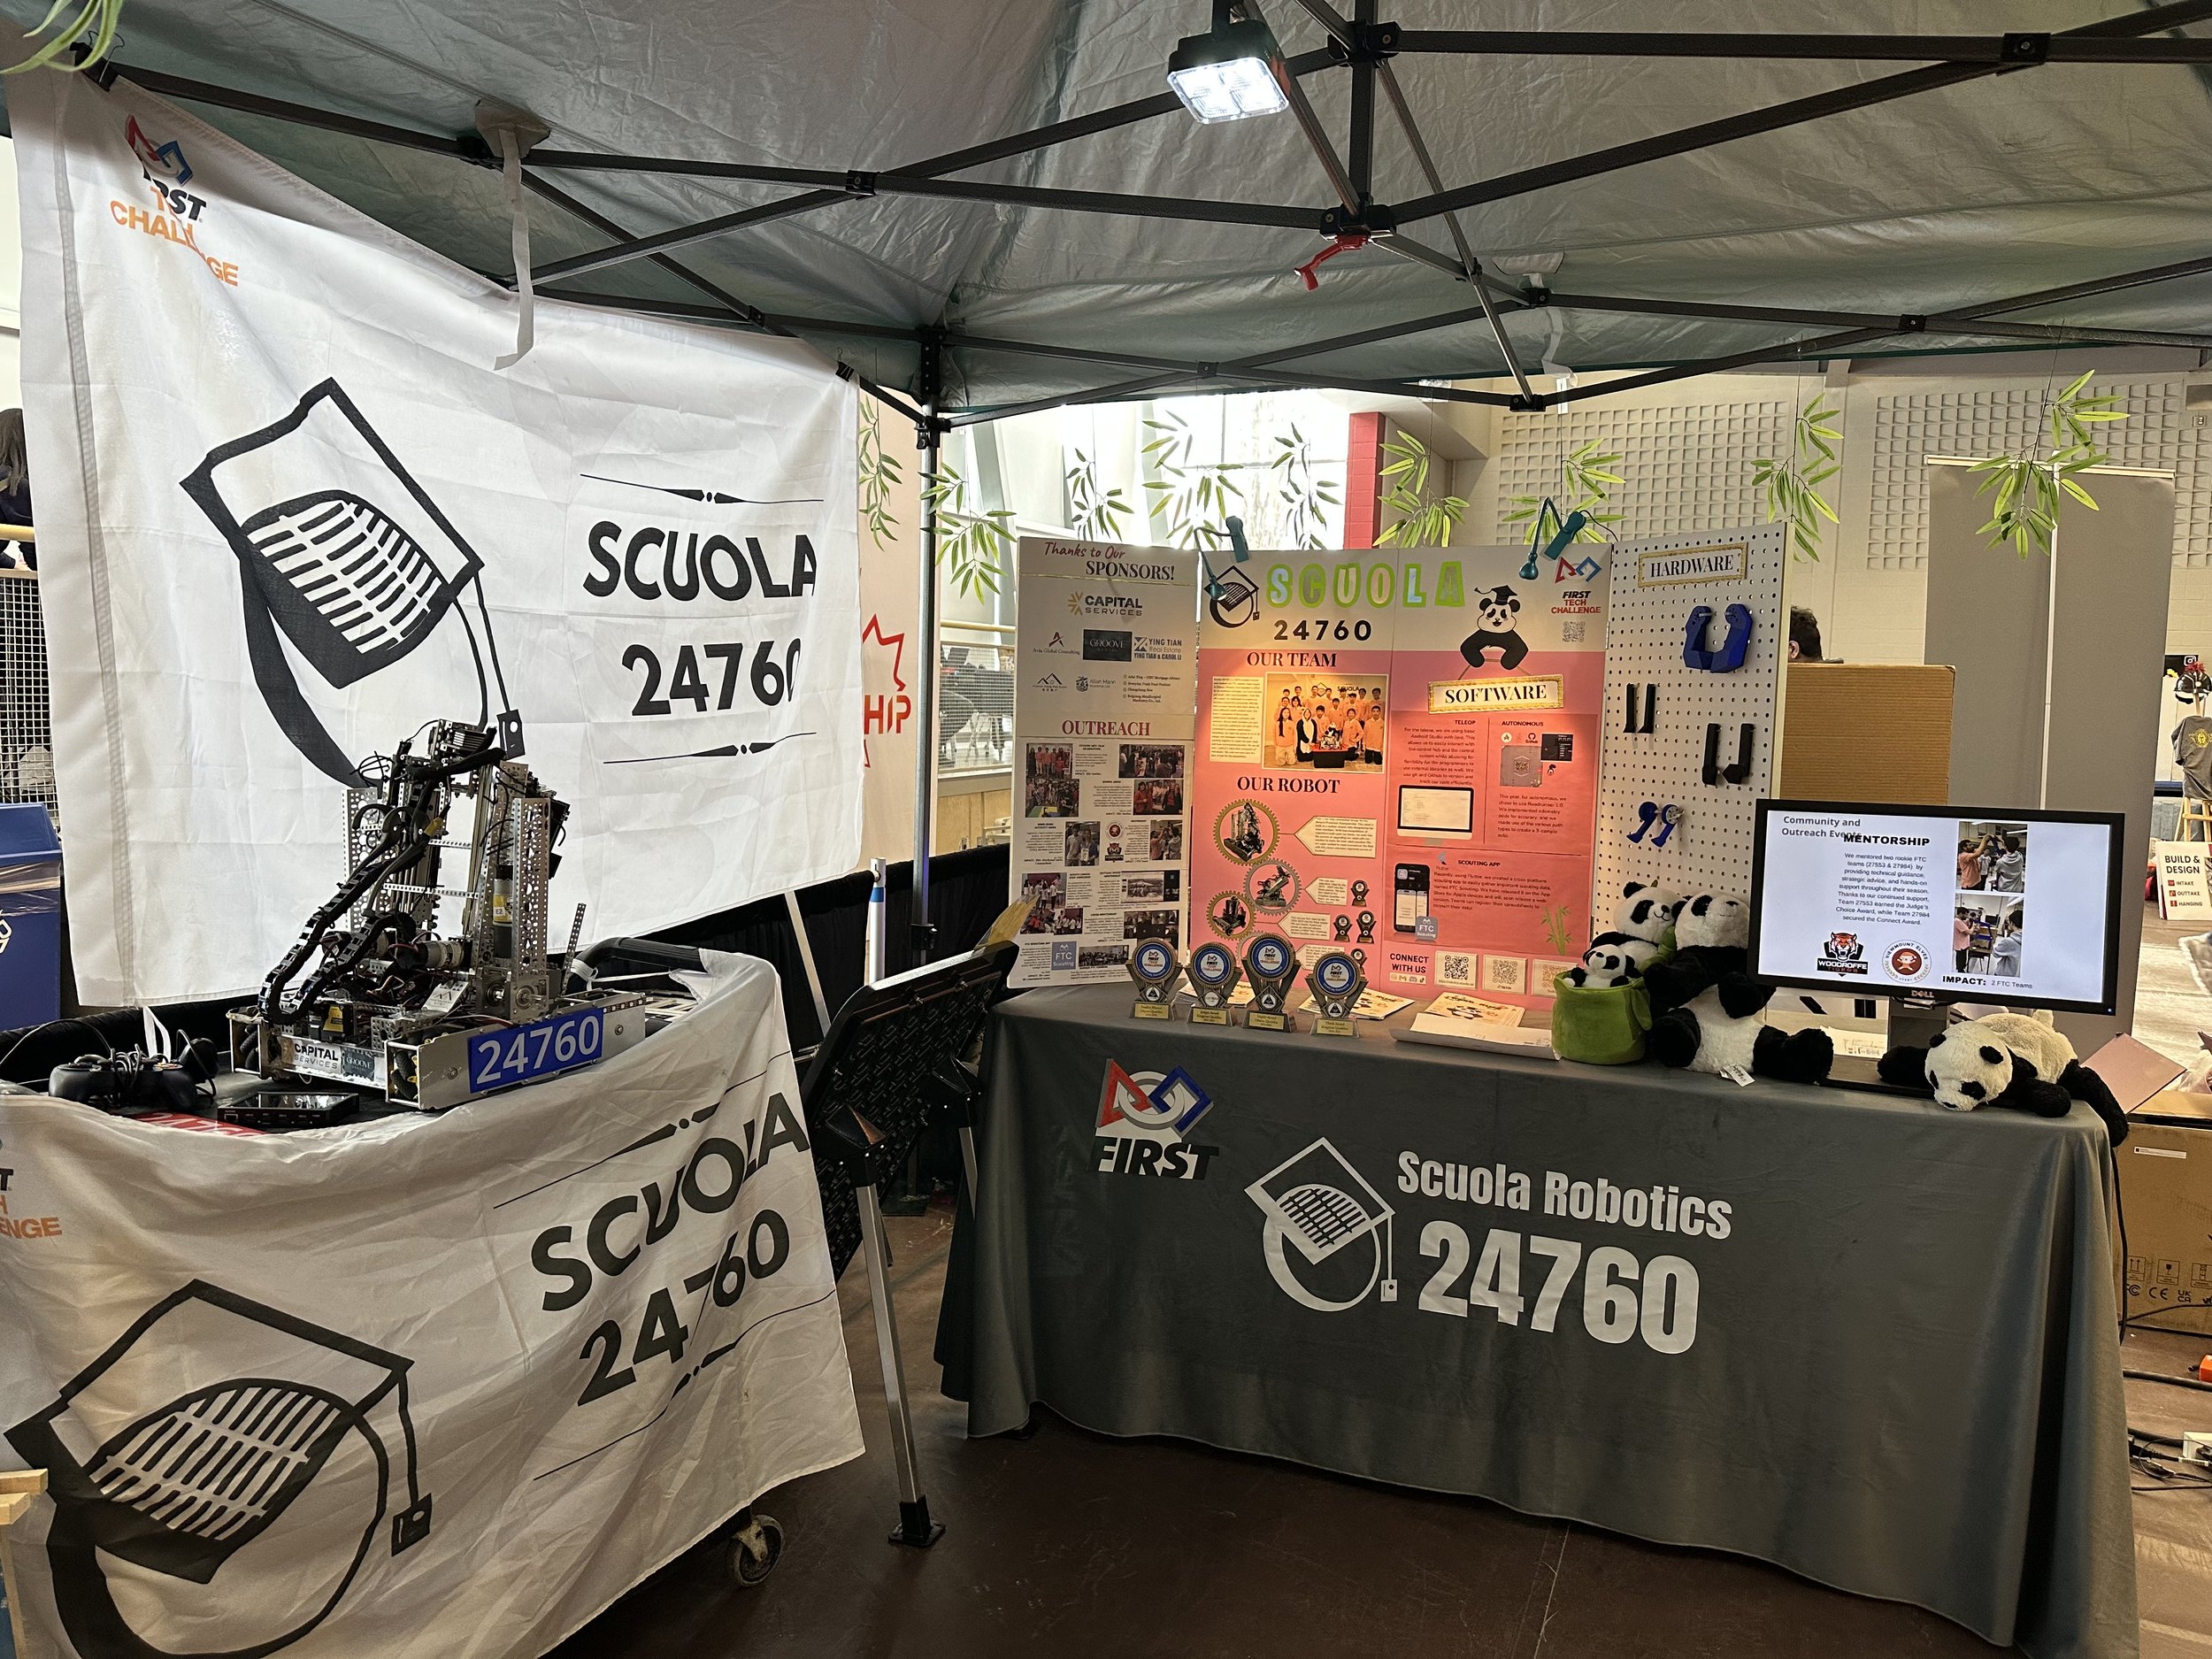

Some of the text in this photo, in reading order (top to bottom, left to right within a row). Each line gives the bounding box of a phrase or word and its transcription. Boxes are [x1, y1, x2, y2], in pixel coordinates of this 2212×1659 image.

[1044, 541, 1125, 559] Thanks to Our
[582, 520, 818, 602] SCUOLA
[1650, 554, 1734, 578] HARDWARE
[1086, 560, 1175, 580] SPONSORS!
[1266, 562, 1465, 608] SCUOLA
[1085, 595, 1143, 609] CAPITAL
[1563, 590, 1592, 599] FIRST
[1085, 607, 1143, 617] SERVICES
[1273, 619, 1372, 641] 24760
[1148, 638, 1166, 647] YING
[1247, 651, 1338, 668] OUR TEAM
[1445, 684, 1547, 704] SOFTWARE
[1062, 719, 1150, 736] OUTREACH
[1237, 776, 1340, 795] OUR ROBOT
[1783, 816, 1861, 828] Community and
[1781, 827, 1827, 838] Outreach
[1843, 834, 1931, 847] MENTORSHIP
[2166, 865, 2200, 874] DESIGN
[1418, 924, 1434, 933] FTC
[1055, 951, 1072, 961] FTC
[1389, 953, 1430, 964] CONNECT
[1391, 963, 1426, 973] WITH US
[1942, 975, 1986, 986] IMPACT:
[294, 1043, 339, 1061] CAPITAL
[476, 1016, 600, 1085] 24760
[294, 1054, 338, 1070] SERVICES
[1095, 1137, 1219, 1180] FIRST
[531, 1092, 810, 1311] SCUOLA
[1398, 1150, 1733, 1240] Scuola Robotics
[1417, 1219, 1700, 1355] 24760
[577, 1209, 790, 1407] 24760
